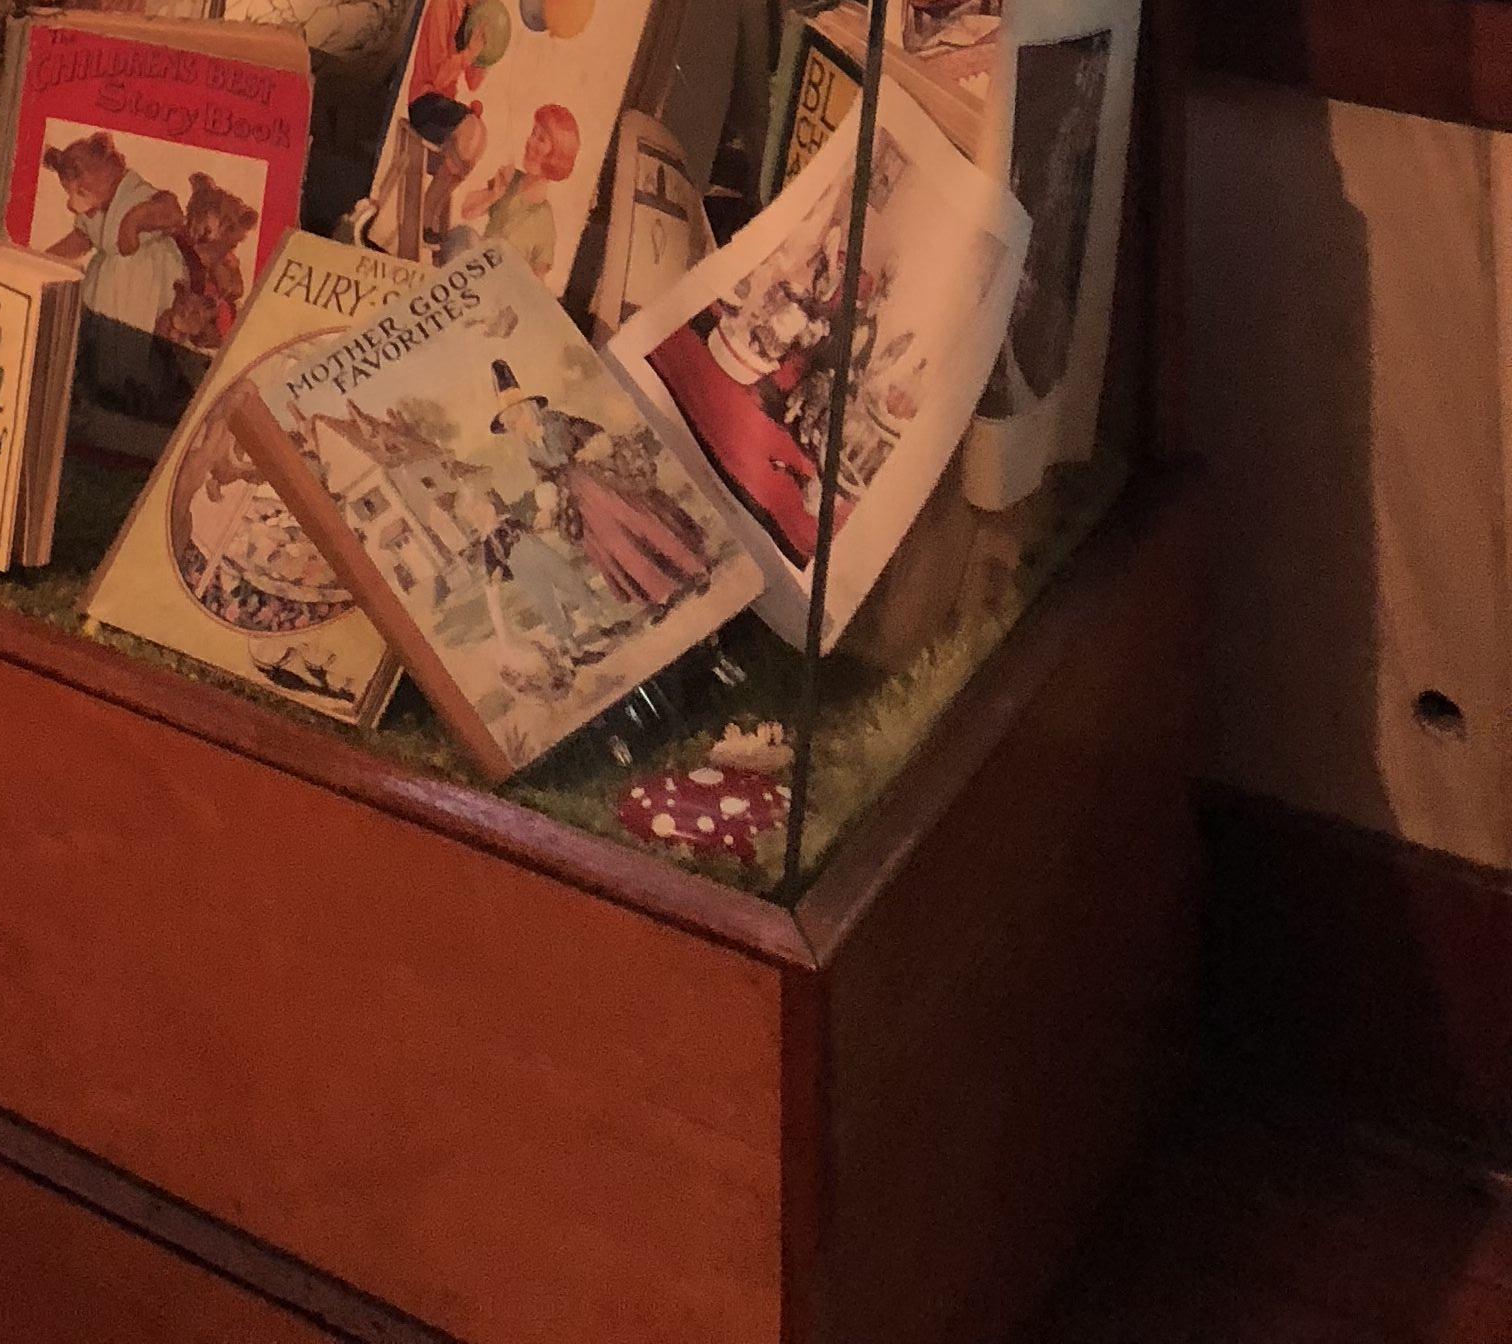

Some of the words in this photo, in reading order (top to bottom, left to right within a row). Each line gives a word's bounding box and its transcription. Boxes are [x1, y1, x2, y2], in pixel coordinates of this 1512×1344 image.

[286, 315, 405, 401] MOTHER
[408, 248, 503, 317] GOOSE
[331, 288, 482, 395] FAVORITES
